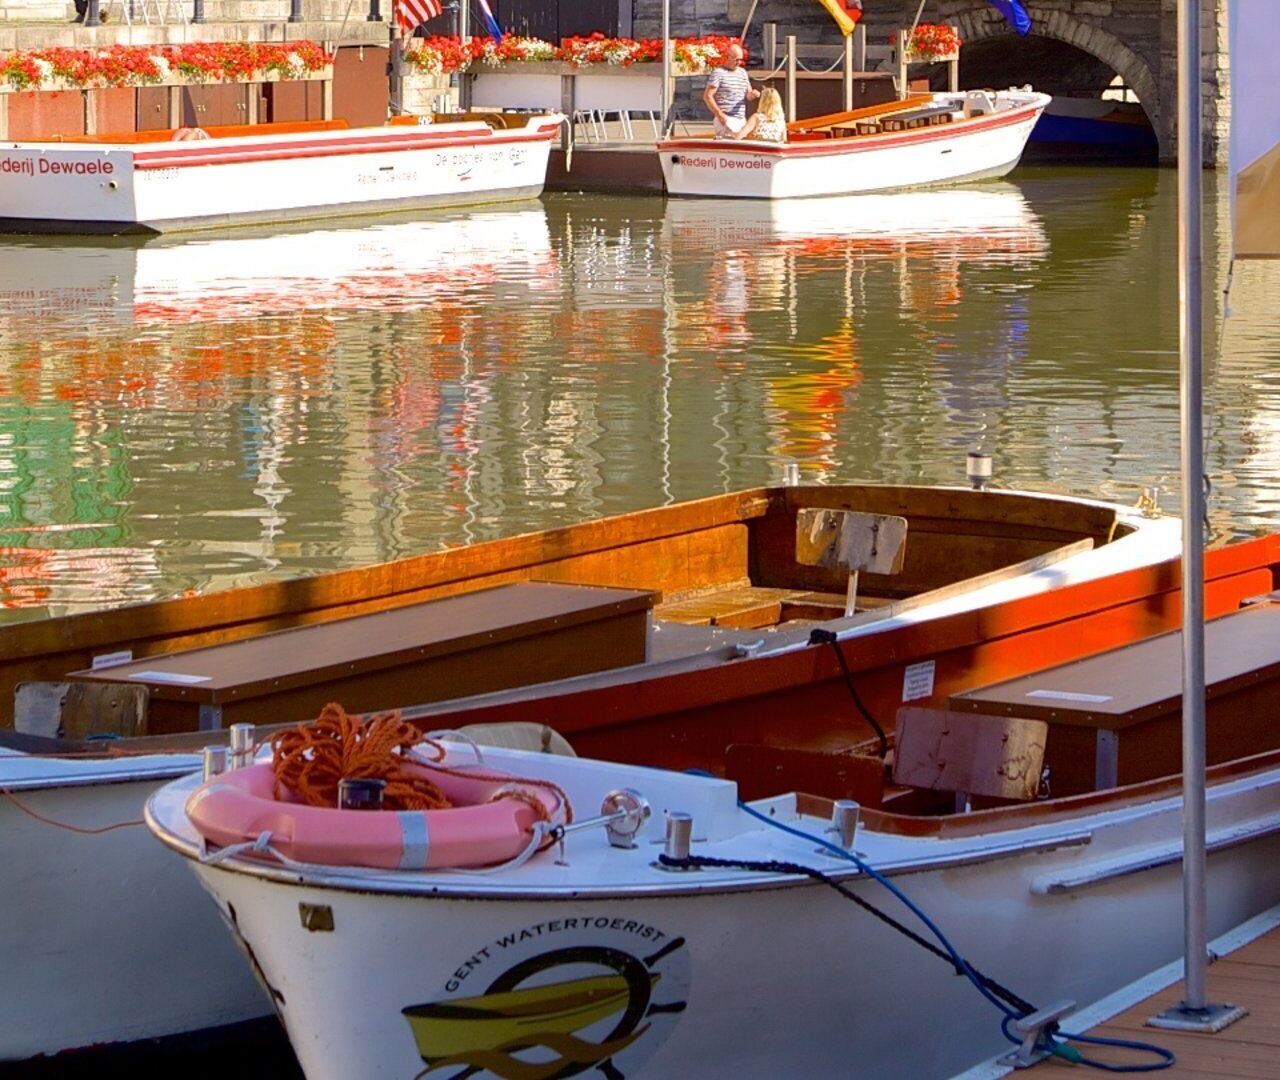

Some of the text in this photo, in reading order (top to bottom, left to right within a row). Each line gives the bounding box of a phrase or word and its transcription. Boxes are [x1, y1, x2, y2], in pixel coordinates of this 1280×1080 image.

[38, 157, 114, 175] Dewaele
[680, 155, 772, 170] Rederij Dewaele
[445, 916, 666, 993] GENT WATERTOERIST
